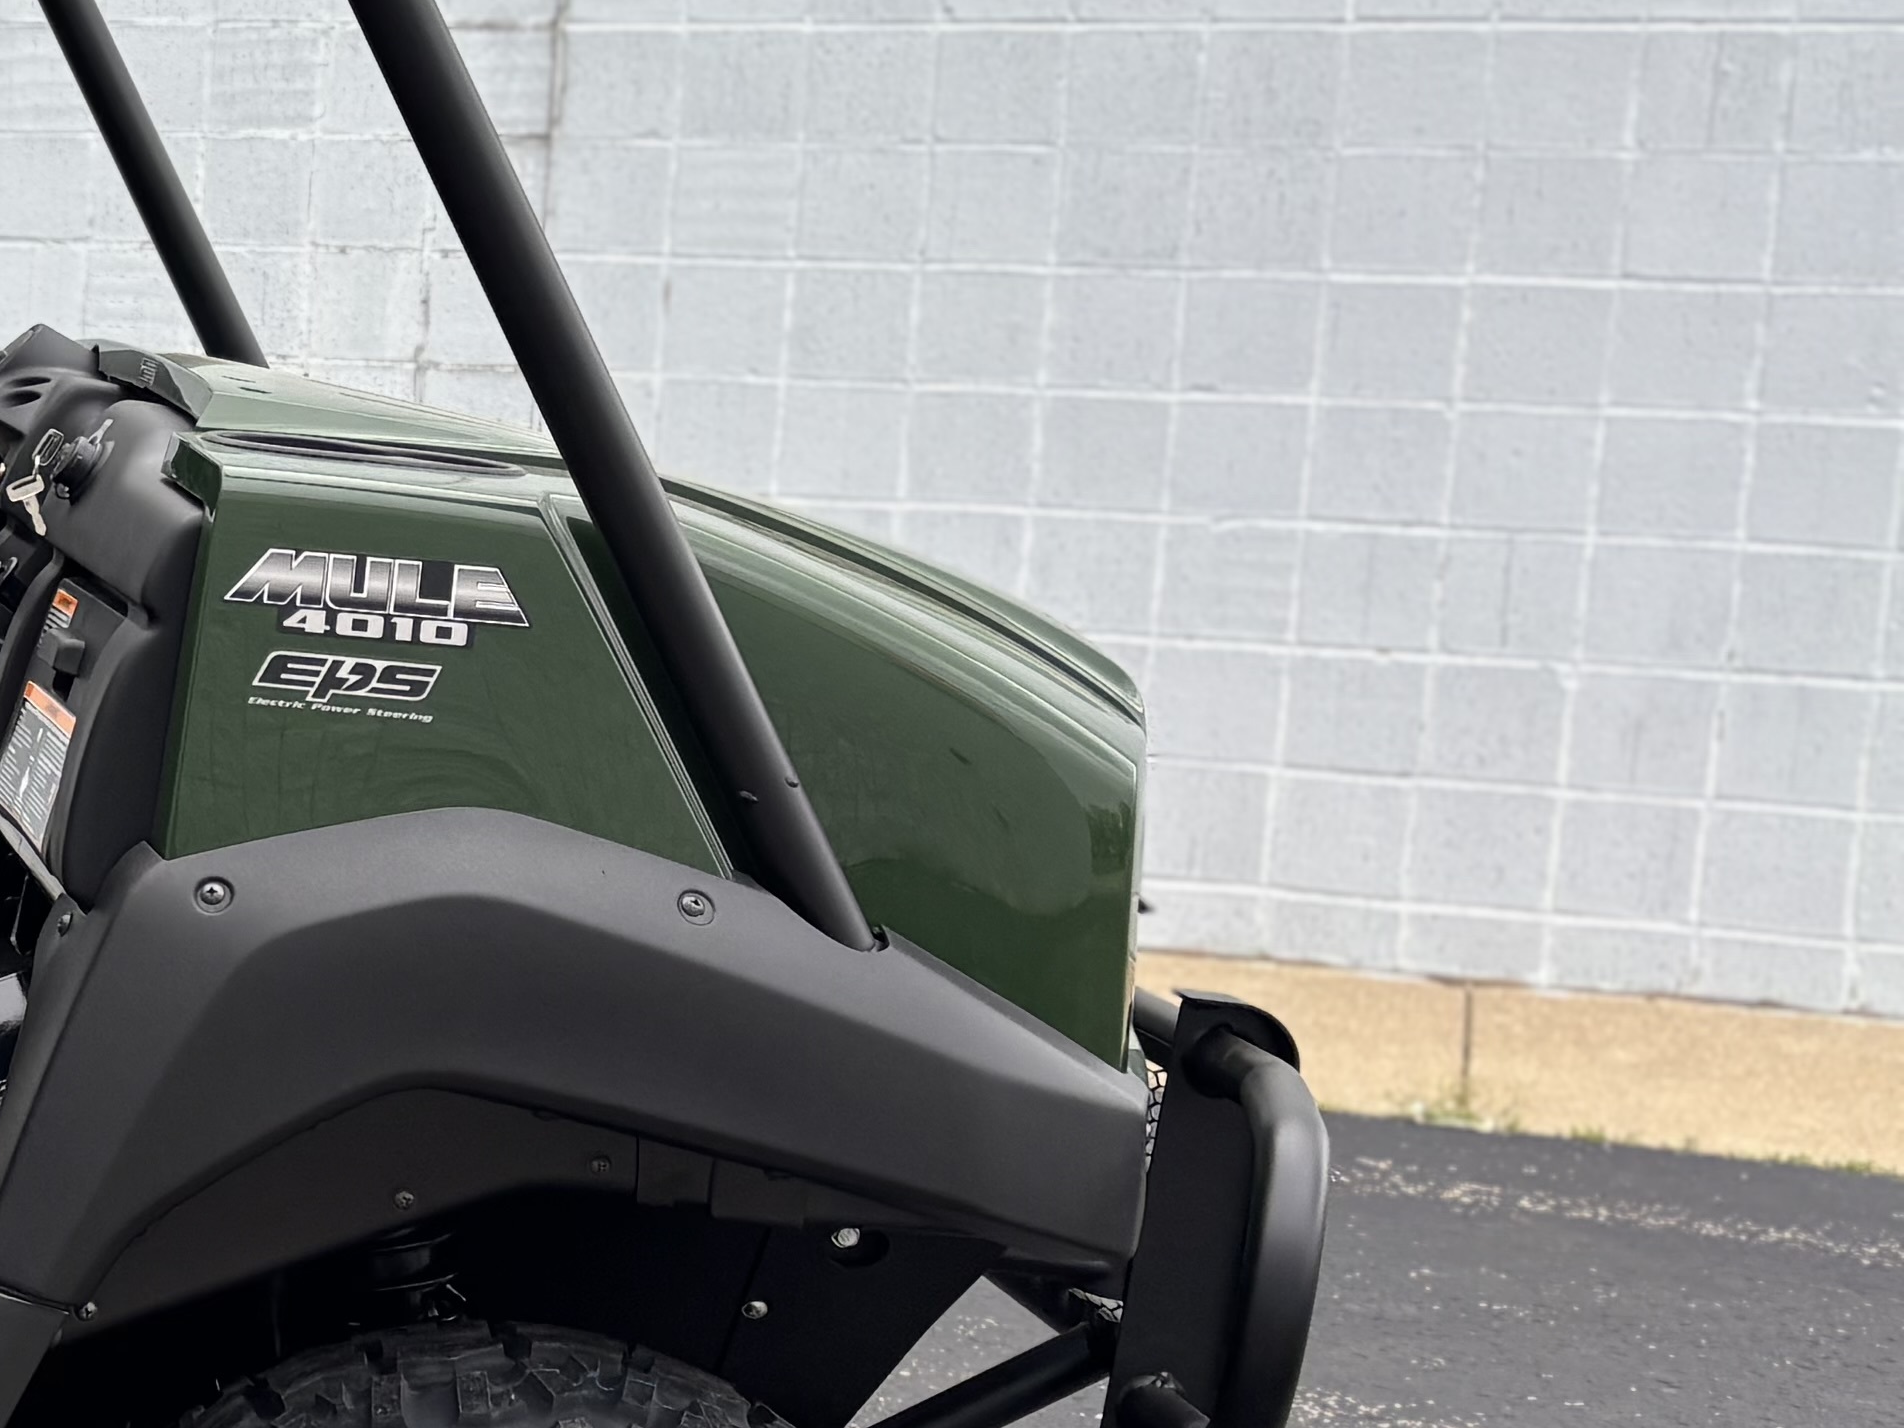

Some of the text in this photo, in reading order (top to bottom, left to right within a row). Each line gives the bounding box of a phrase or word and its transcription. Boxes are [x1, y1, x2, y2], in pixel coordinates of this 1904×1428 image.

[223, 548, 530, 627] MULE
[282, 609, 469, 647] 4010
[247, 696, 434, 724] Electric Power Steering
